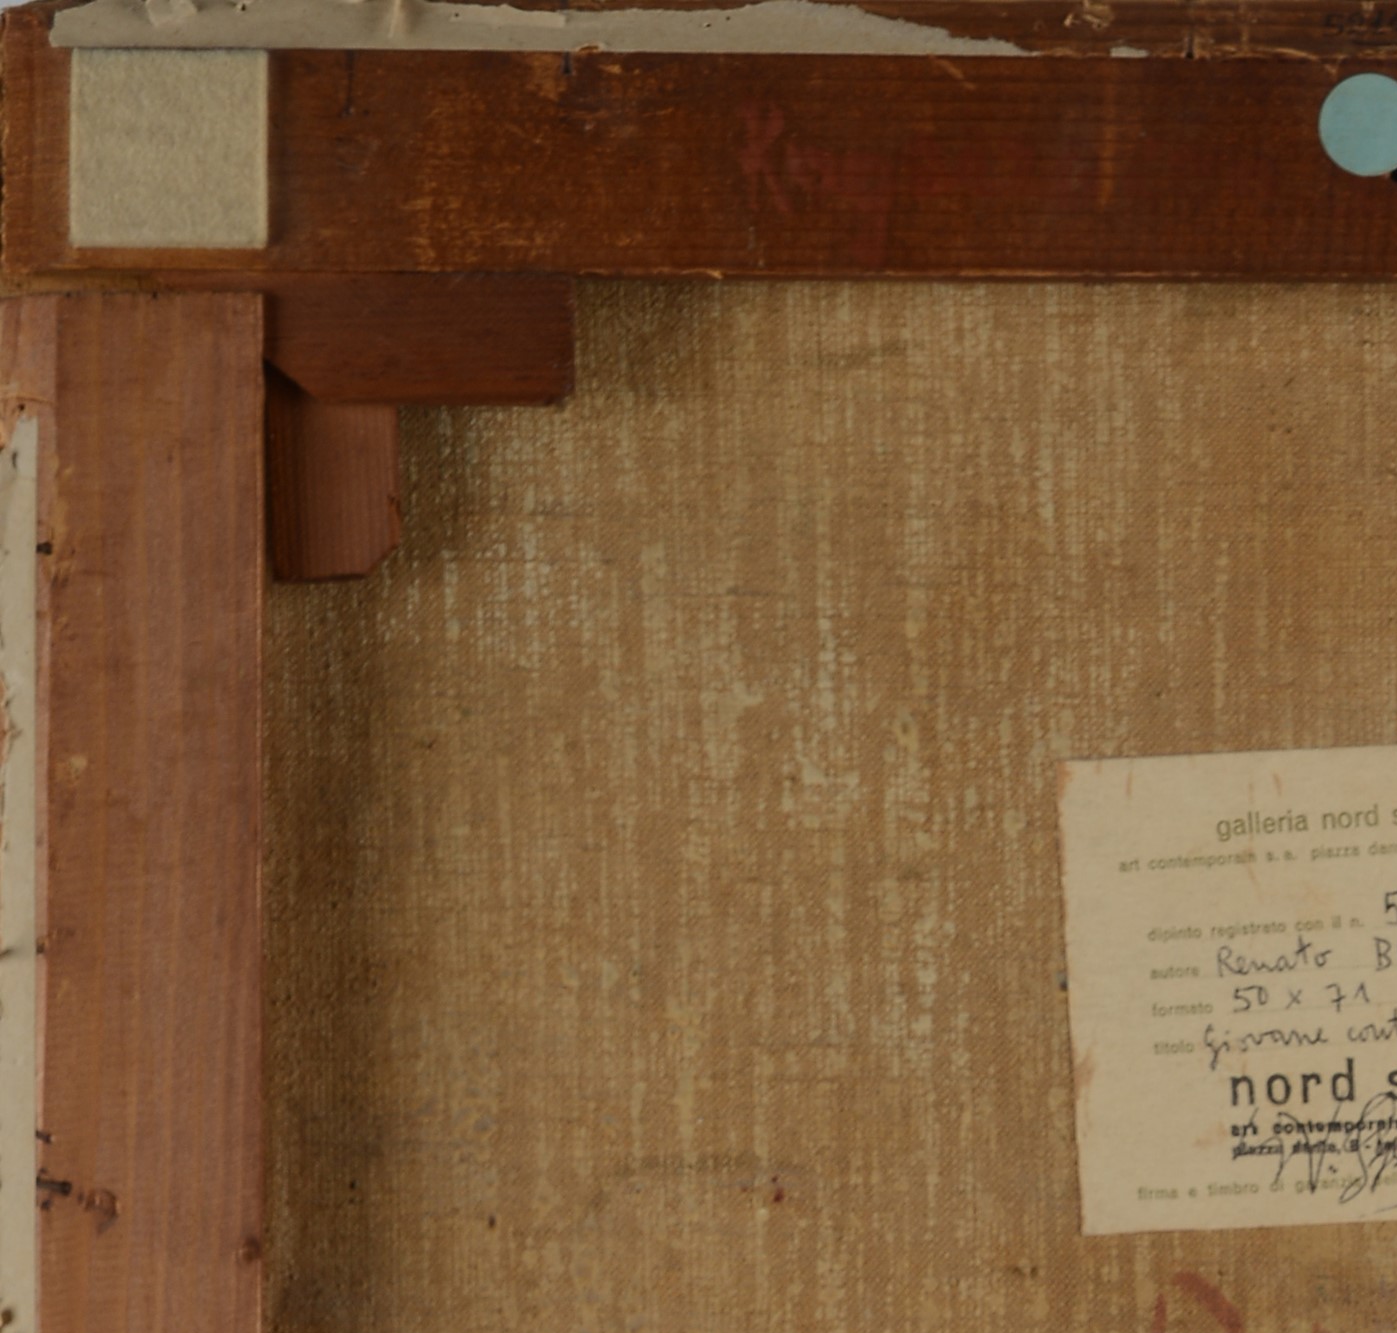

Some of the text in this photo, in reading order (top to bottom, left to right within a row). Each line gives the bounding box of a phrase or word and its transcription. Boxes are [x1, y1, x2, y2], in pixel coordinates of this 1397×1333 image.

[1216, 808, 1309, 842] galleria
[1322, 803, 1379, 830] nord
[1118, 857, 1140, 873] art
[1310, 845, 1360, 862] piazza
[1147, 926, 1203, 943] dipinto
[1210, 920, 1287, 940] registrato
[1293, 918, 1325, 932] con
[1150, 966, 1201, 981] autore
[1216, 935, 1333, 979] Renato
[1151, 1003, 1215, 1018] formato
[1232, 985, 1271, 1014] 50
[1325, 981, 1371, 1014] 71
[1153, 1040, 1195, 1055] titolo
[1230, 1057, 1355, 1106] nord
[1206, 1181, 1260, 1198] timbro
